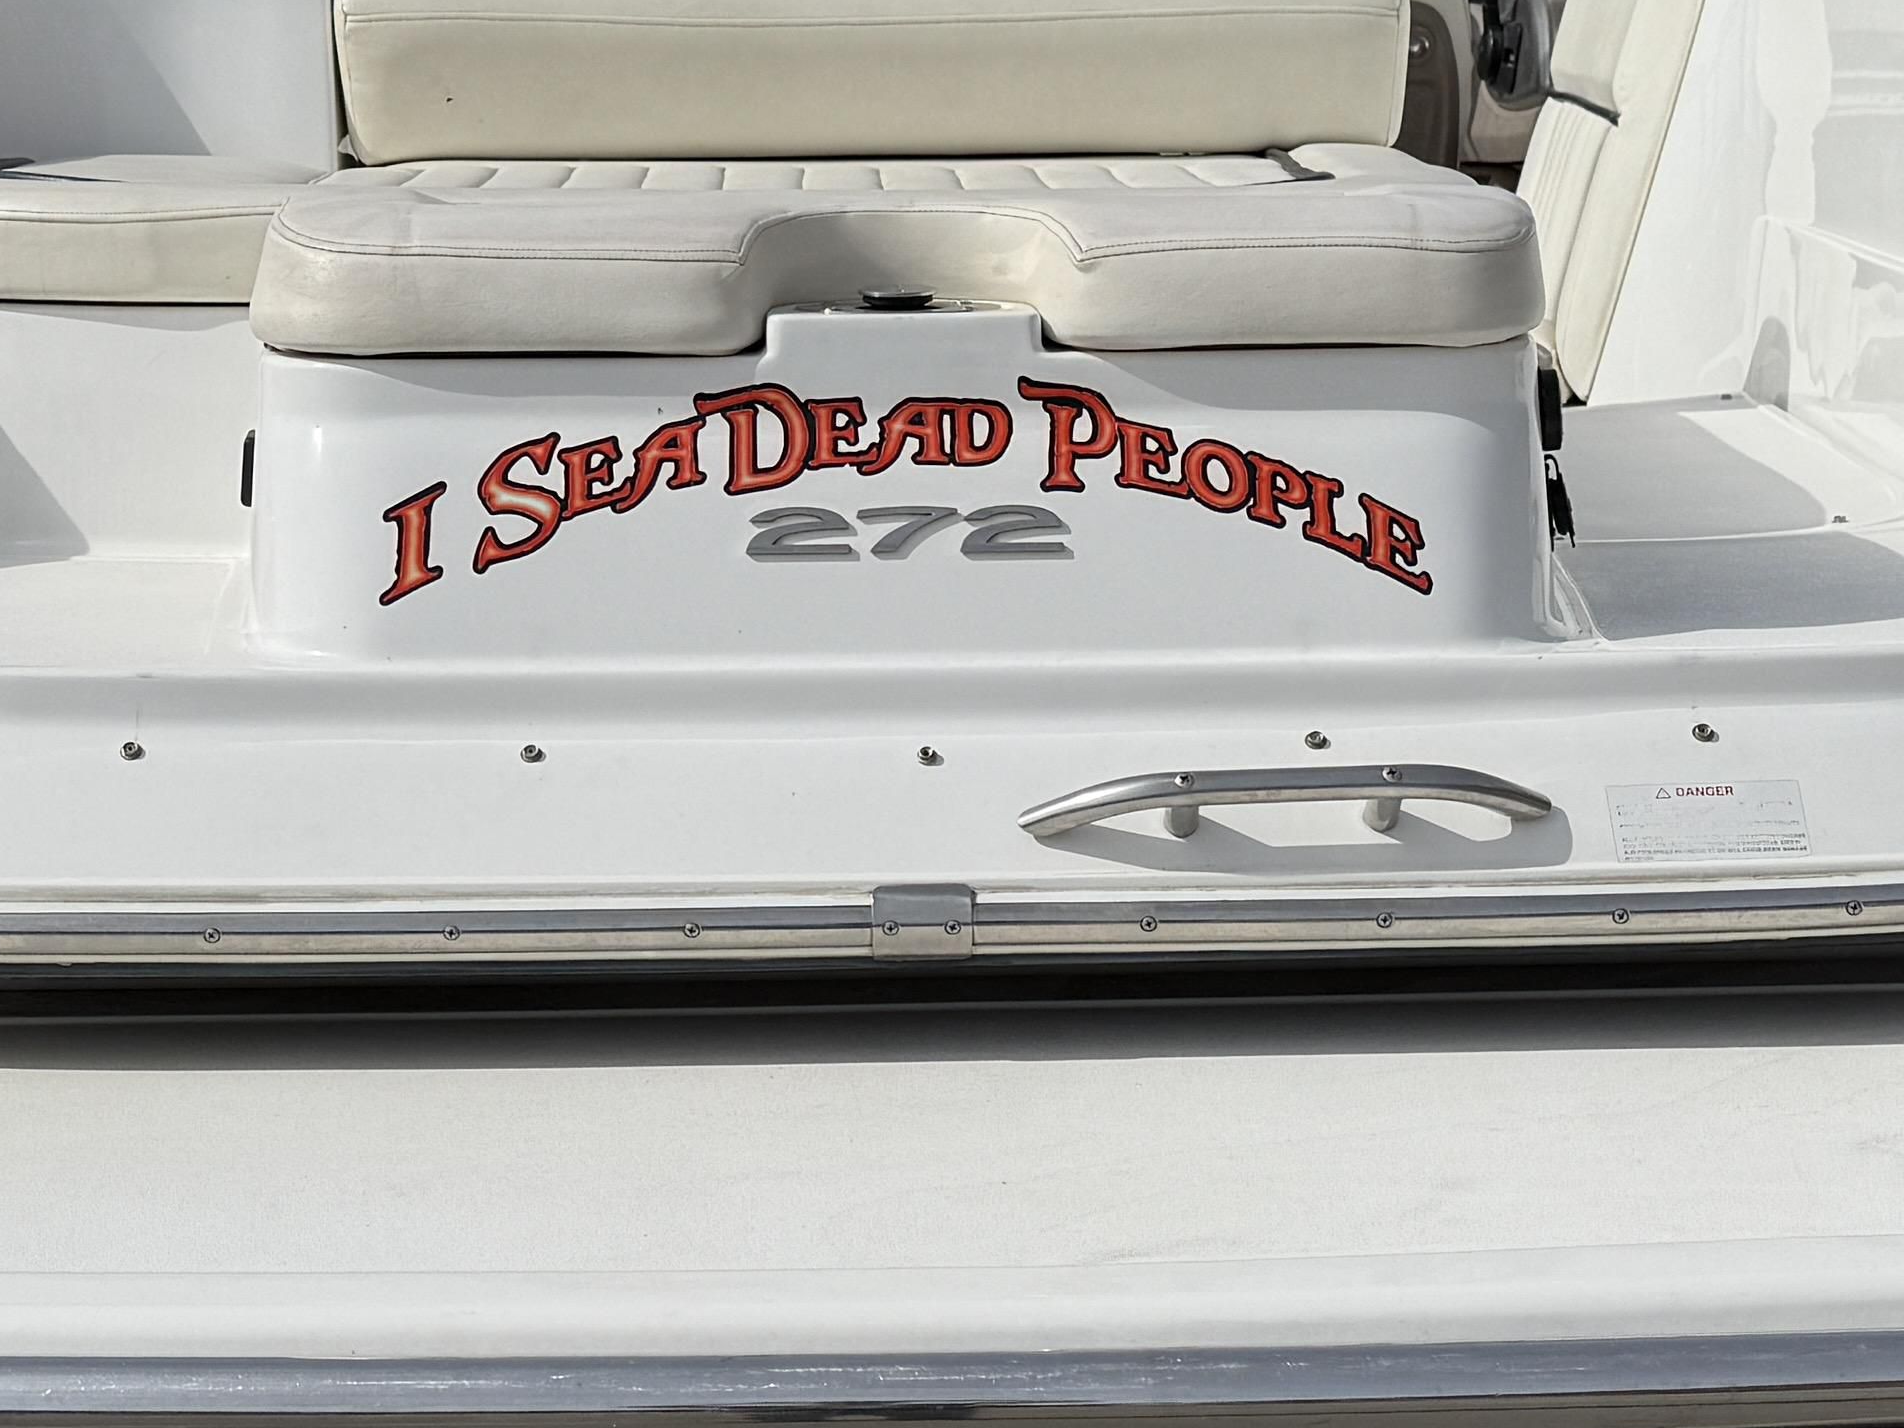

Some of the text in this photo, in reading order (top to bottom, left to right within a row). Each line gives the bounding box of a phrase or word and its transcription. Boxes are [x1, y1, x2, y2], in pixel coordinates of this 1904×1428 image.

[379, 375, 1434, 606] I SEA DEAD PEOPLE
[745, 505, 1075, 562] 272
[1675, 785, 1735, 797] DANGER
